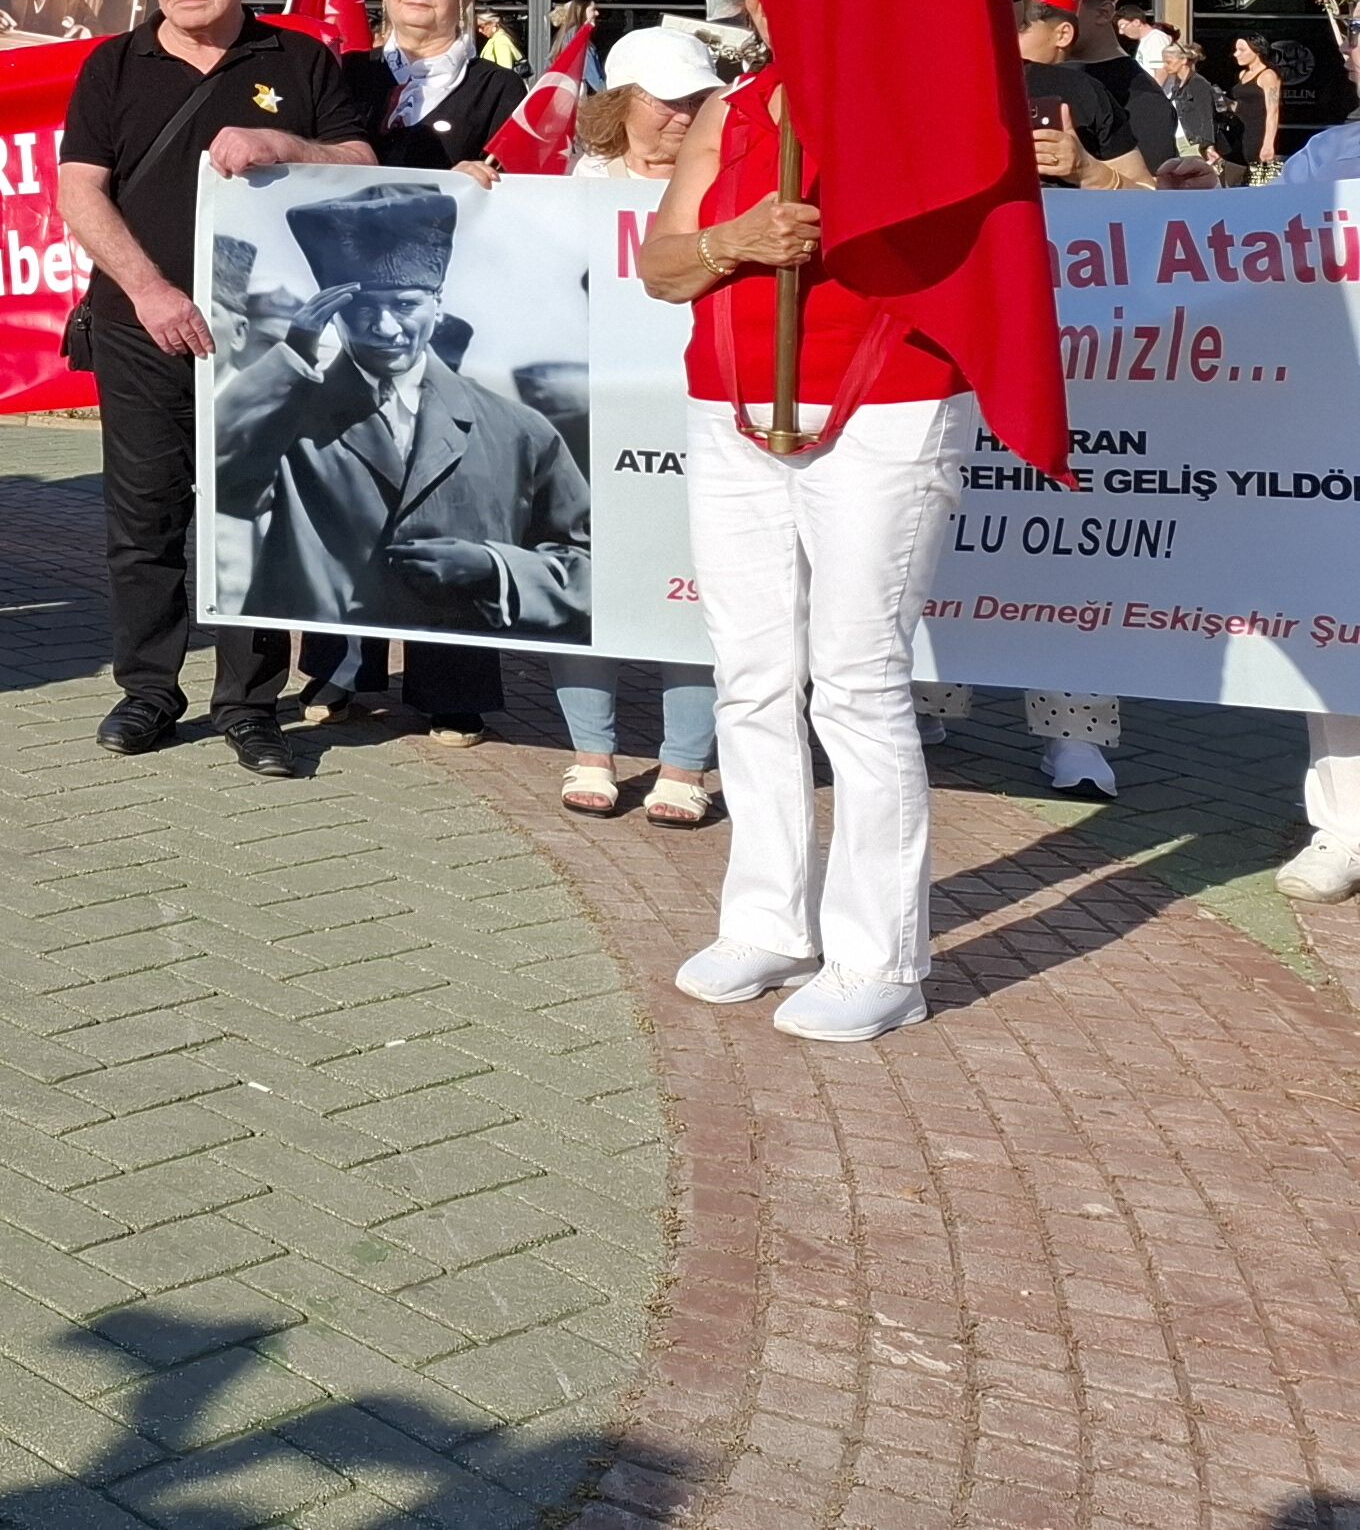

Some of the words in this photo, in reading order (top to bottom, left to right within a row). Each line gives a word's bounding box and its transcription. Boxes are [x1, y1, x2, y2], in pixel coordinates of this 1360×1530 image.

[1059, 306, 1287, 382] mizle...
[975, 427, 1147, 455] HRAN
[614, 449, 687, 476] ATA
[1103, 464, 1218, 502] GELİŞ
[1226, 469, 1360, 502] YILDÖ
[950, 514, 1008, 554] LU
[1022, 516, 1177, 559] OLSUN!
[922, 598, 963, 619] arı
[973, 595, 1113, 632] Derneği
[1122, 602, 1301, 639] Eskişehir
